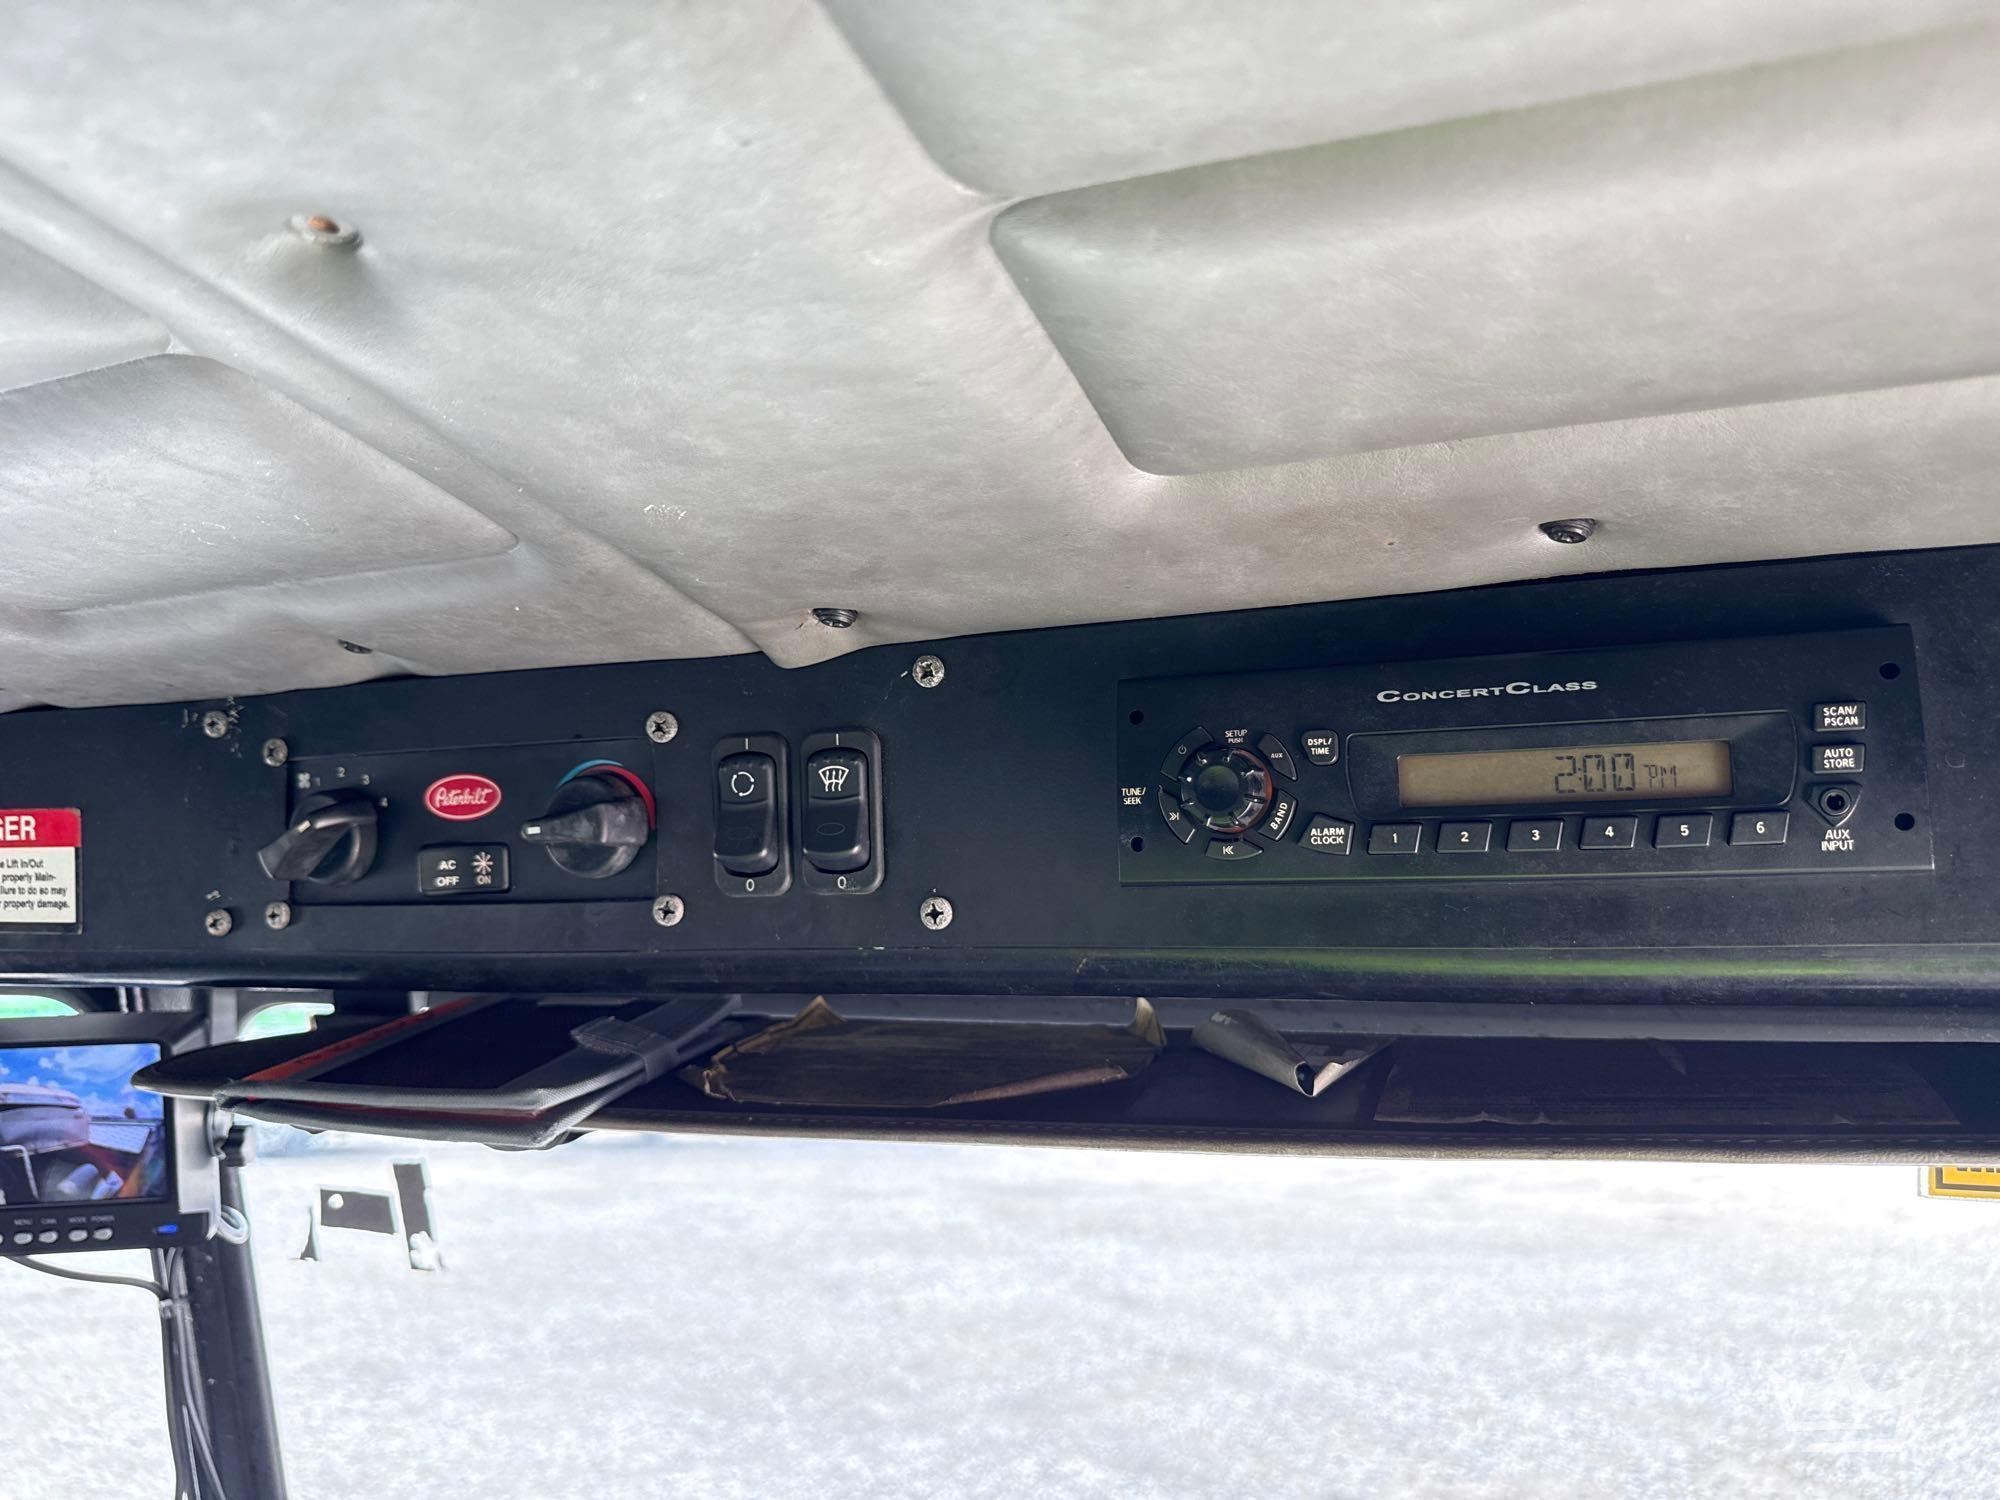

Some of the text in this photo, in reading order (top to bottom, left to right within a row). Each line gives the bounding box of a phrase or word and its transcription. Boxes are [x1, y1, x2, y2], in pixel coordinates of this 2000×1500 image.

[1823, 705, 1857, 716] SCAN/
[1825, 716, 1859, 726] PSCAN
[1225, 729, 1248, 738] SETUP
[1307, 738, 1332, 747] DSPL/
[1311, 747, 1330, 755] TIME
[1824, 747, 1854, 758] AUTO
[1823, 757, 1855, 768] STORE
[336, 767, 346, 778] 2
[1554, 753, 1678, 793] 2:00 PM
[361, 774, 370, 786] 3
[435, 786, 493, 808] Peterbilt
[1121, 787, 1146, 797] TUNE/
[380, 797, 389, 808] 4
[1123, 796, 1142, 805] SEEK
[1270, 802, 1288, 830] BAND
[1310, 827, 1345, 837] ALARM
[1604, 826, 1614, 838] 4
[1680, 825, 1689, 836] 5
[1756, 822, 1765, 834] 6
[1310, 835, 1344, 845] CLOCK
[1392, 833, 1398, 843] 1
[1460, 832, 1469, 842] 2
[1531, 829, 1540, 841] 3
[1824, 829, 1851, 840] AUX
[1821, 839, 1855, 851] INPUT
[438, 860, 457, 870] AC
[435, 876, 459, 887] OFF
[476, 875, 492, 885] ON
[18, 886, 26, 895] to
[27, 886, 37, 895] do
[39, 887, 49, 895] so
[51, 887, 67, 897] may
[37, 899, 70, 910] damage.
